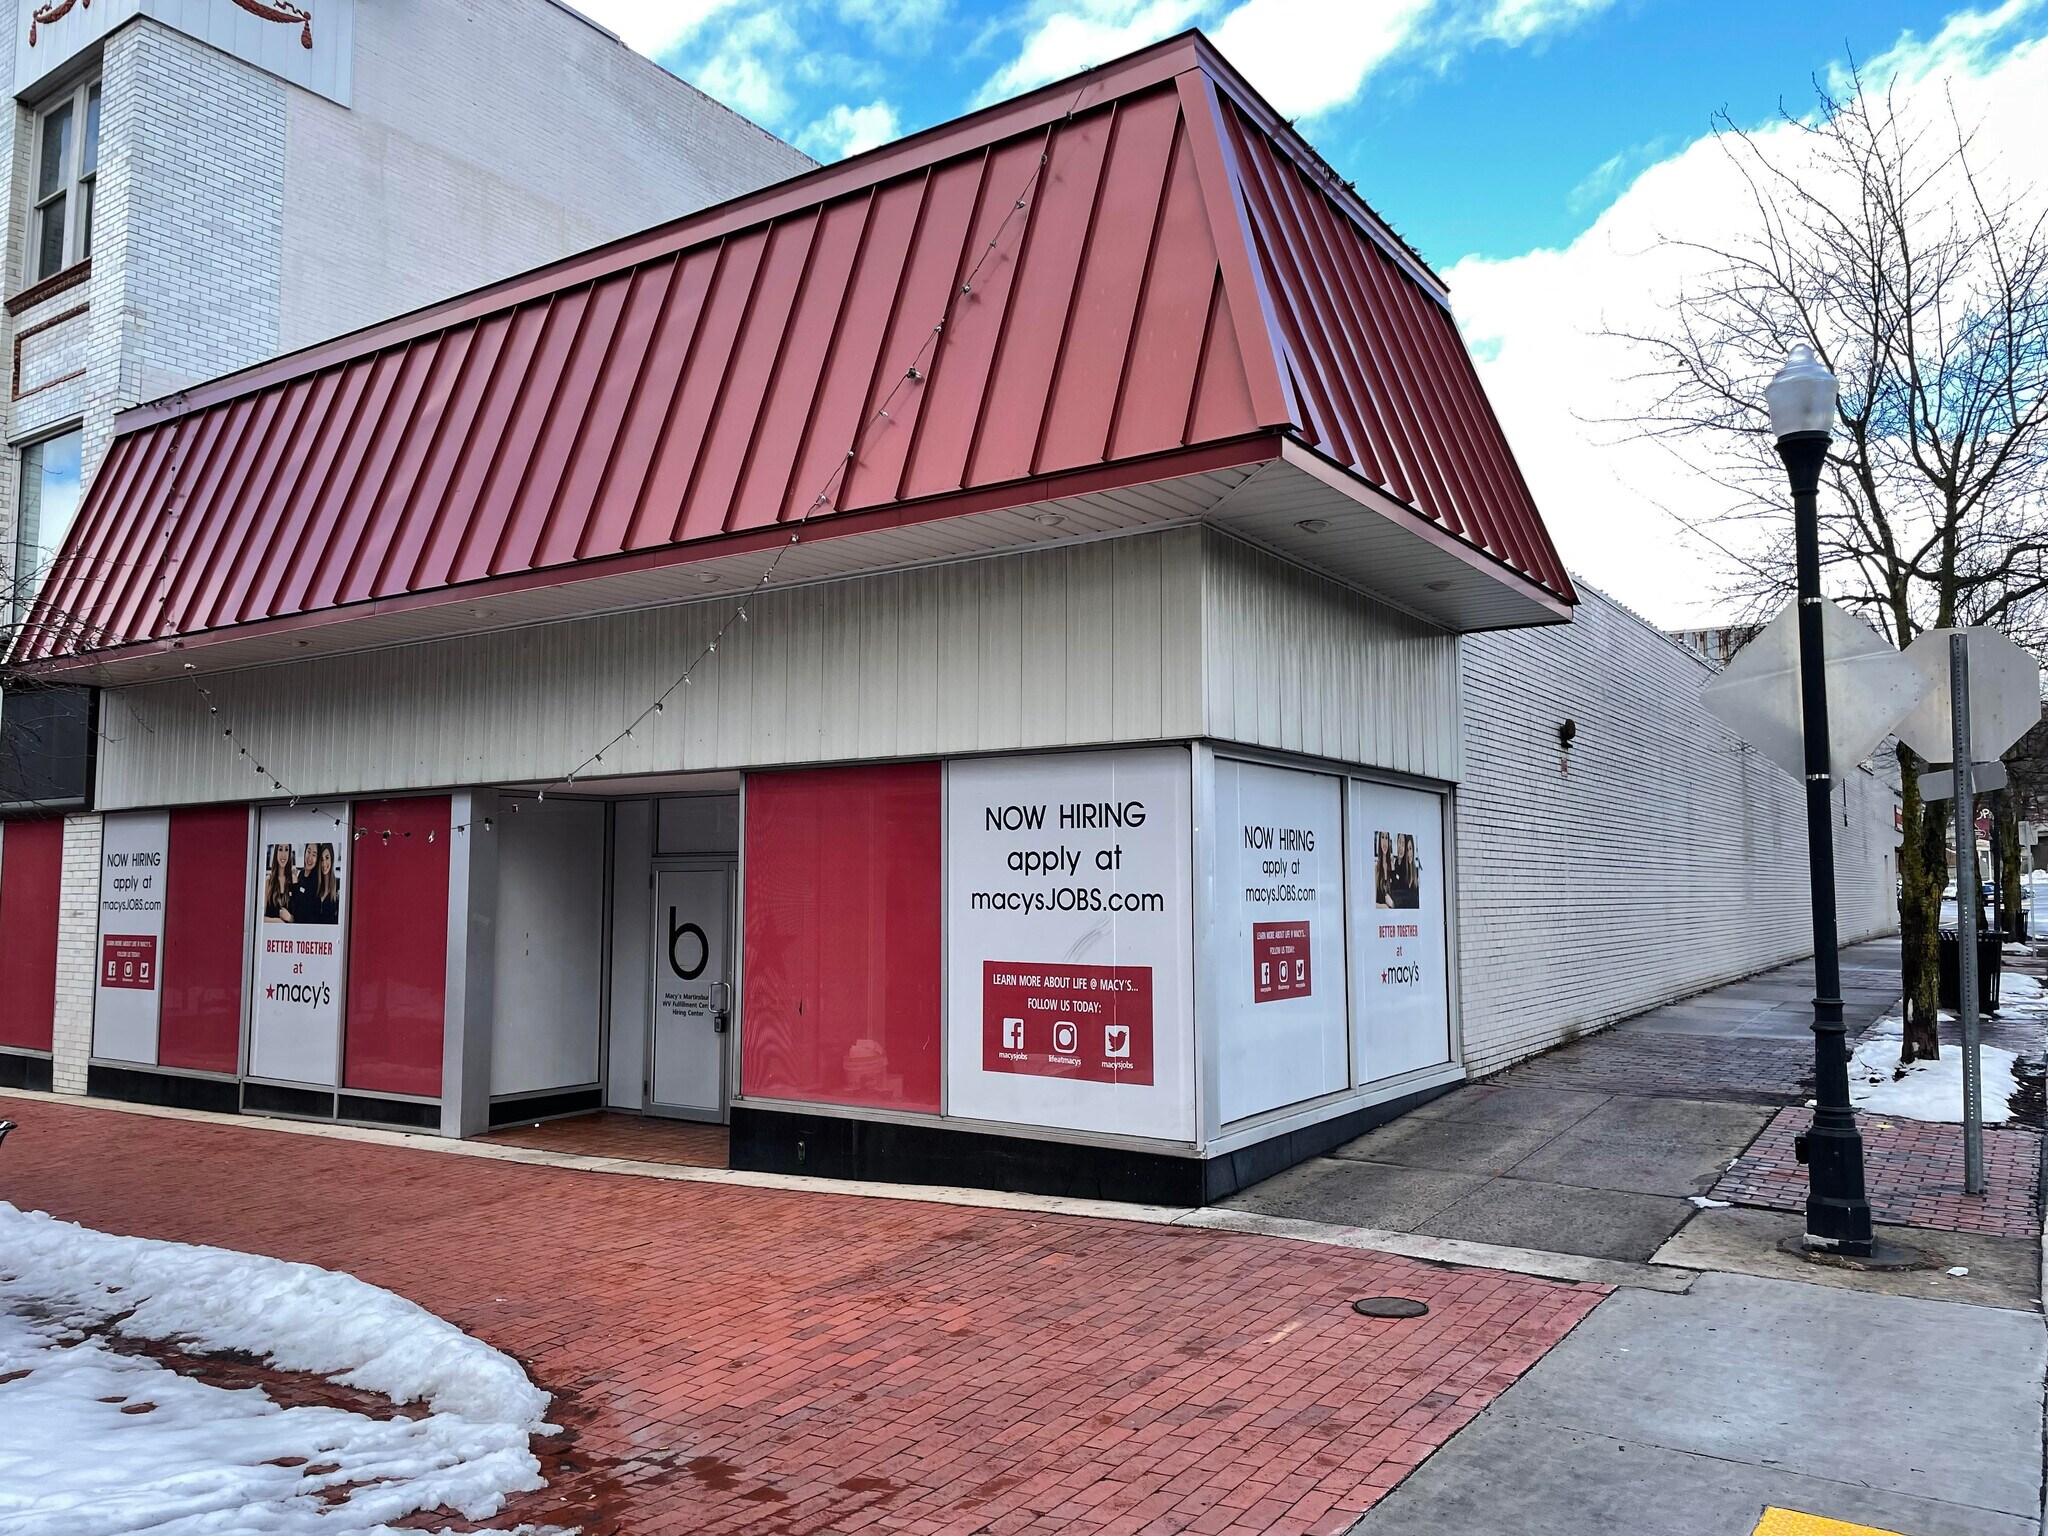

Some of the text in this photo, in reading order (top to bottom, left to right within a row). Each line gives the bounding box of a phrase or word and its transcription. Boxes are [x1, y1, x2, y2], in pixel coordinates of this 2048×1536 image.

[985, 801, 1146, 831] NOW HIRING
[1245, 826, 1315, 852] NOW HIRING
[107, 852, 161, 867] NOW HIRING
[1007, 845, 1122, 876] apply at
[1262, 858, 1300, 878] apply at
[113, 875, 152, 892] apply at
[971, 888, 1164, 915] macysJOBS.com
[1246, 885, 1316, 905] macysJOBS.com
[102, 898, 162, 913] macysJOBS.com
[1379, 925, 1418, 938] BETTER TOGETHER
[266, 940, 333, 955] BETTER TOGETHER
[668, 905, 709, 981] b
[1396, 945, 1402, 957] at
[293, 962, 303, 974] at
[1388, 960, 1420, 987] macy's
[993, 973, 1017, 986] LEARN
[1019, 974, 1041, 987] MORE
[1044, 976, 1070, 989] ABOUT
[1073, 978, 1087, 990] LIFE
[1090, 978, 1098, 990] @
[276, 981, 330, 1010] macy's
[672, 1009, 687, 1017] Hiring
[1027, 998, 1102, 1013] FOLLOW US TODAY:
[999, 1051, 1028, 1061] macysjobs
[1048, 1054, 1082, 1066] lifeatmacys
[1101, 1061, 1134, 1071] macysjobs
